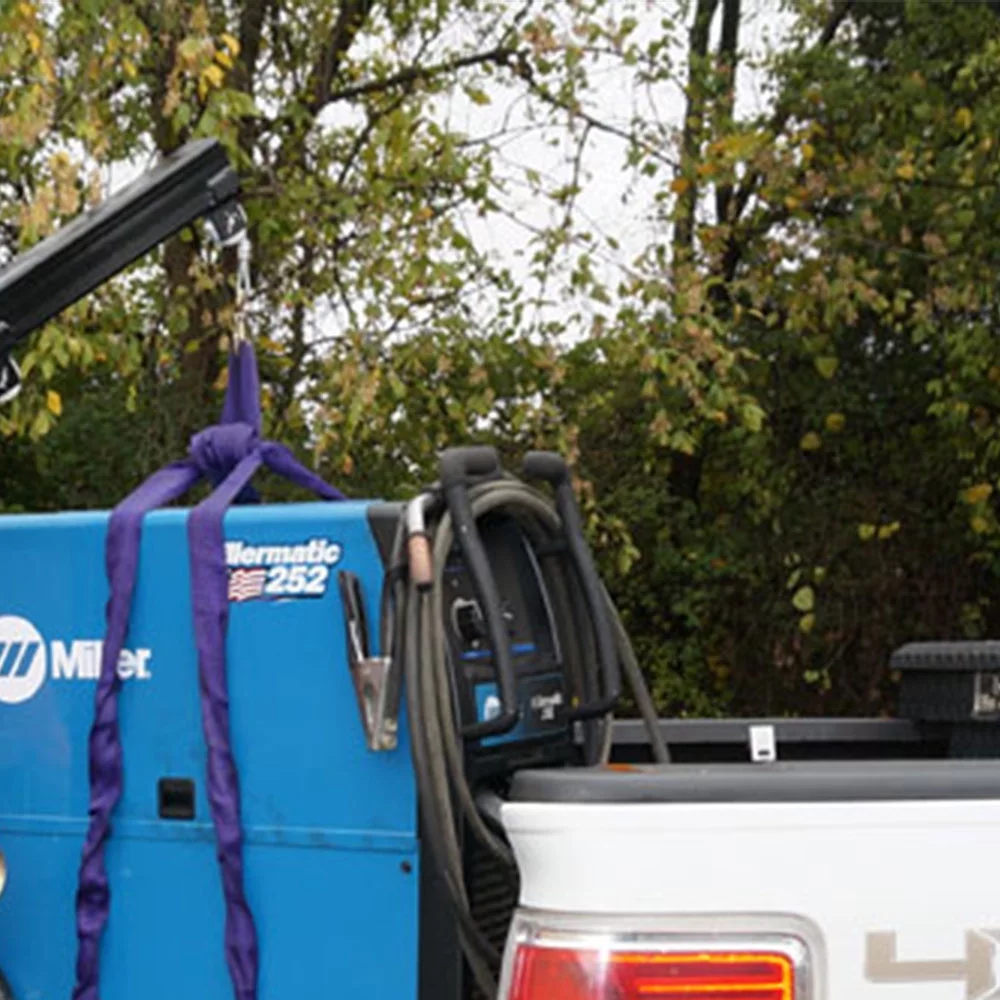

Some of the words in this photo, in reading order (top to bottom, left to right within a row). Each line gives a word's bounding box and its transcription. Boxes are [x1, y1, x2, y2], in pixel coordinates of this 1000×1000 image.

[225, 540, 340, 564] llermatic
[265, 565, 328, 594] 252
[50, 640, 152, 679] Miler
